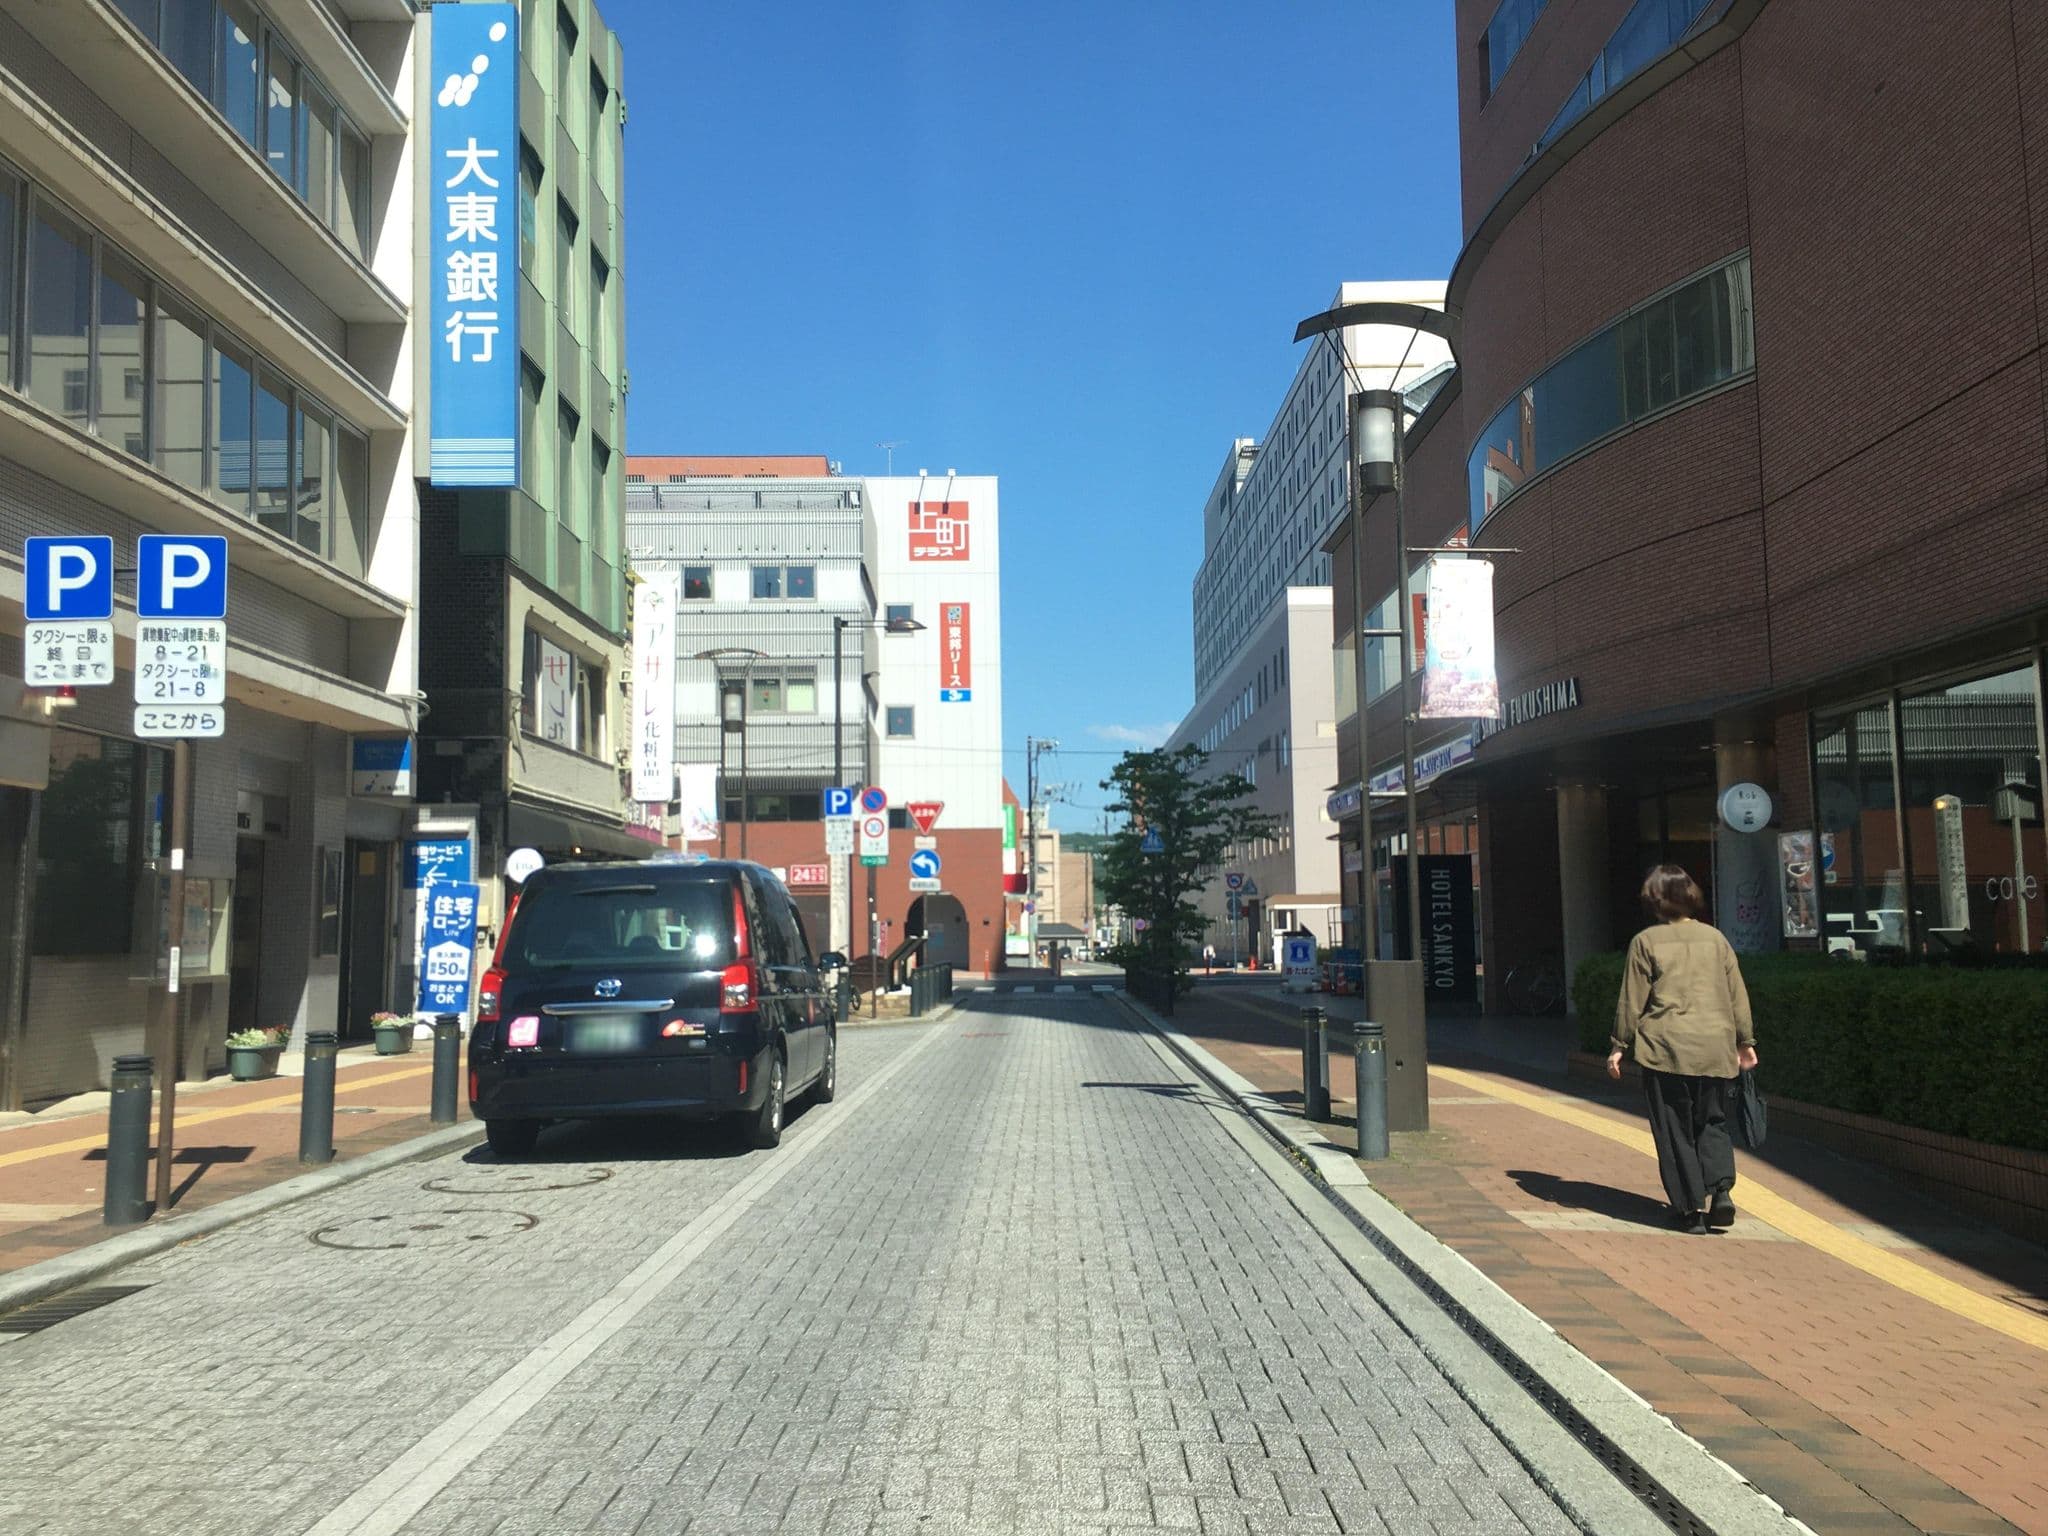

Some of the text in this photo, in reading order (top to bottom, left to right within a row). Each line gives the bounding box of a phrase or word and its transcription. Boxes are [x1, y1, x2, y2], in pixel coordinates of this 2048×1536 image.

[445, 137, 499, 363] 大東銀行
[908, 500, 969, 550] 上町
[914, 546, 954, 557] テラス
[48, 545, 97, 611] P
[161, 543, 211, 609] P
[32, 627, 108, 644] タクシーに限る
[33, 663, 106, 679] ここまで
[142, 663, 219, 678] タクシーに限る
[154, 681, 206, 697] 21-8
[1509, 677, 1578, 726] FUKUSHIMA
[142, 713, 217, 730] ここから
[831, 790, 848, 813] P
[1985, 875, 2038, 901] coe
[434, 895, 474, 915] 住宅
[433, 915, 471, 929] ローン
[1430, 869, 1455, 988] HOTEL SANKYO
[435, 993, 456, 1004] OK
